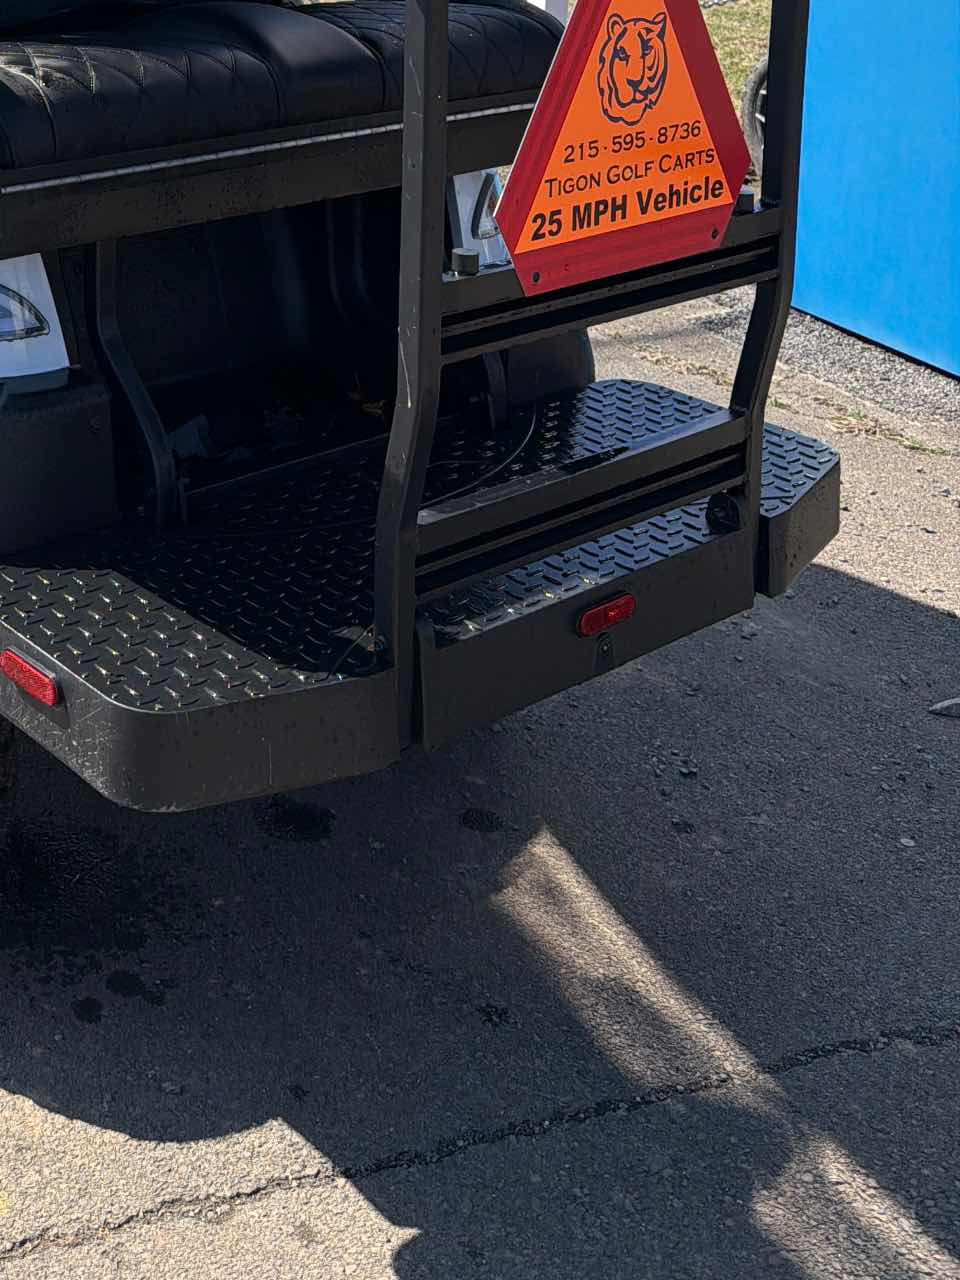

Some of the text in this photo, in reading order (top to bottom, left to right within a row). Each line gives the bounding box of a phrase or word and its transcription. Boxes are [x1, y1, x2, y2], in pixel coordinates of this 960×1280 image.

[544, 148, 715, 197] TIGON GOLF CARTS
[531, 175, 724, 241] 25 MPH Vehicle
